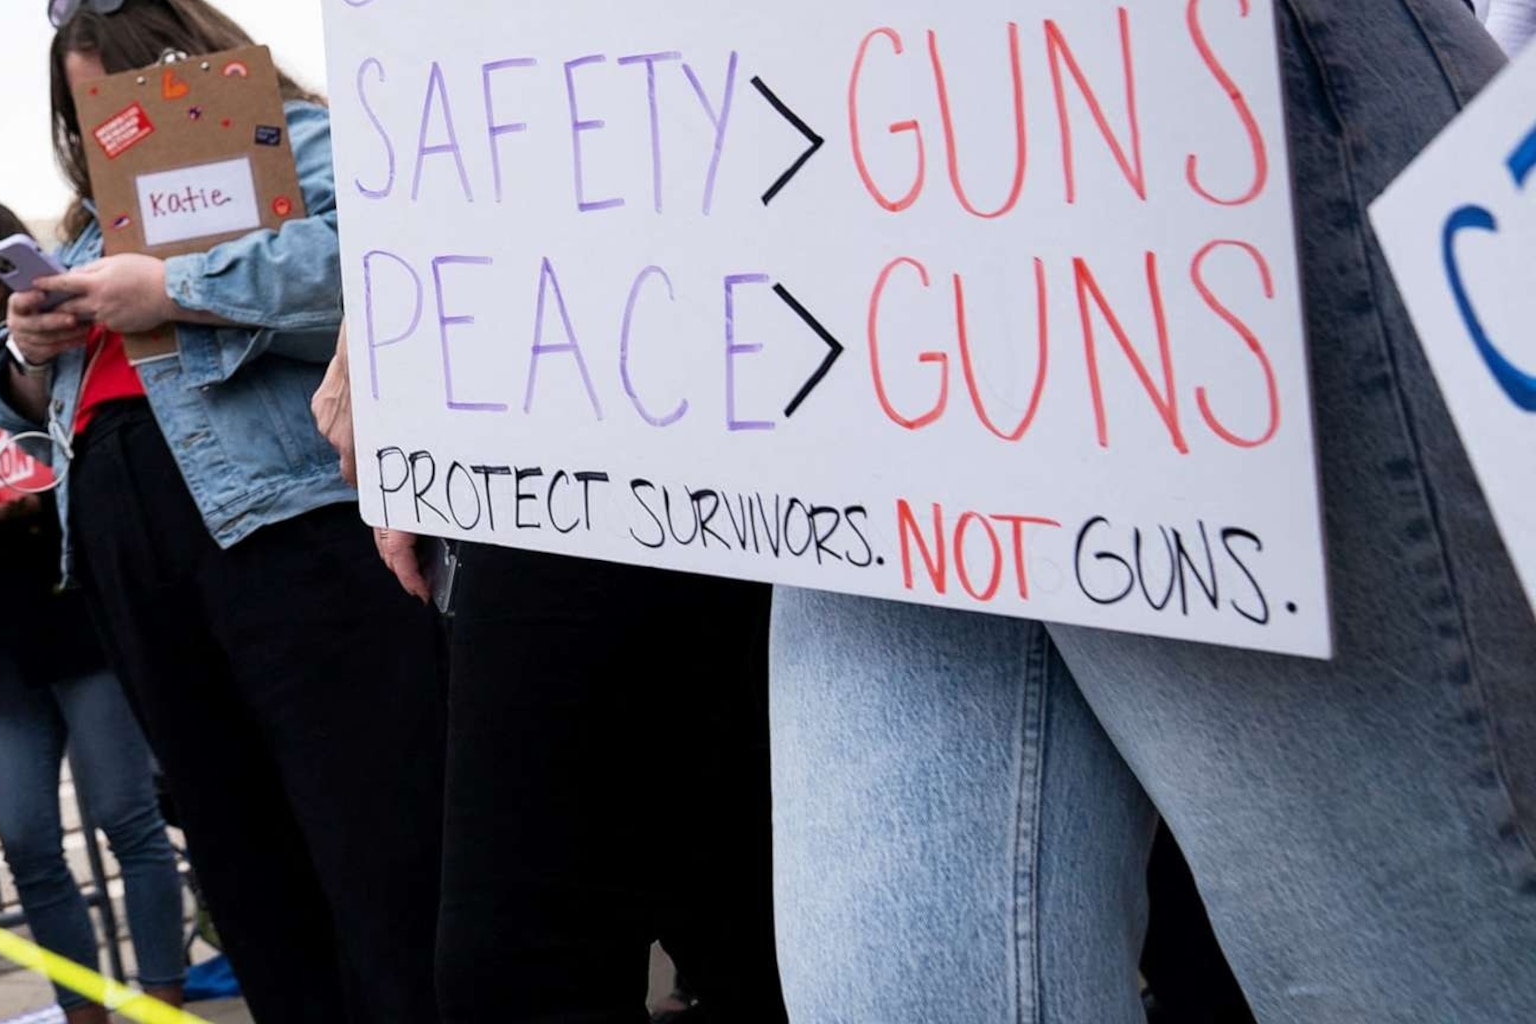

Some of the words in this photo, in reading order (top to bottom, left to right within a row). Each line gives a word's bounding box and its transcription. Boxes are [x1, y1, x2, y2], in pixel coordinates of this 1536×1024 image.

[148, 186, 232, 218] Katie
[355, 49, 740, 215] SAFETY
[361, 249, 779, 434] PEACE
[868, 240, 1281, 456] GUNS
[376, 444, 610, 528] PROTECT
[628, 478, 885, 568] SURVIVORS.
[896, 497, 1061, 602] NOT
[1073, 515, 1298, 626] GUNS.
